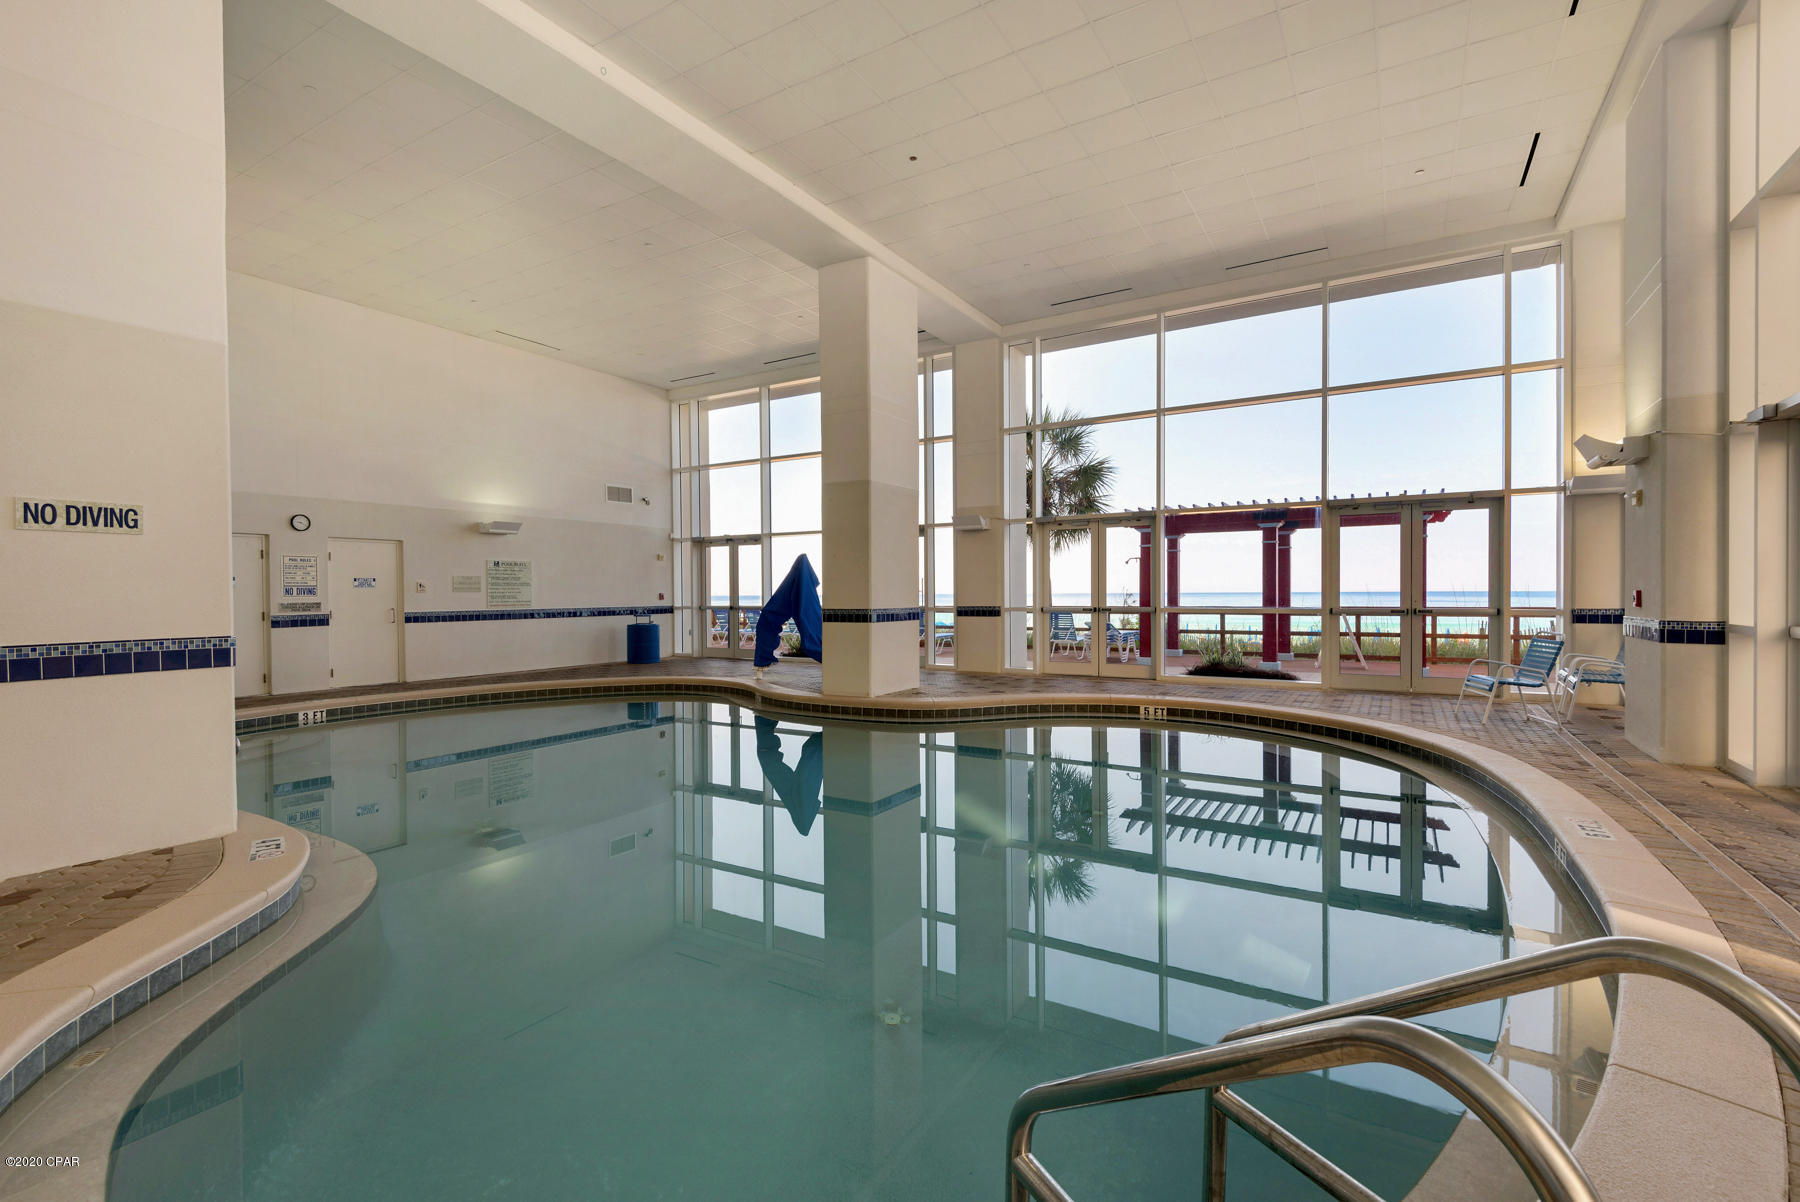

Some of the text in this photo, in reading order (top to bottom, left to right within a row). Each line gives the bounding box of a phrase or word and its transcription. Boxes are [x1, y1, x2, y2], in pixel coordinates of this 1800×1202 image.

[23, 502, 139, 529] NO DIVING
[284, 588, 317, 596] NO DIVING
